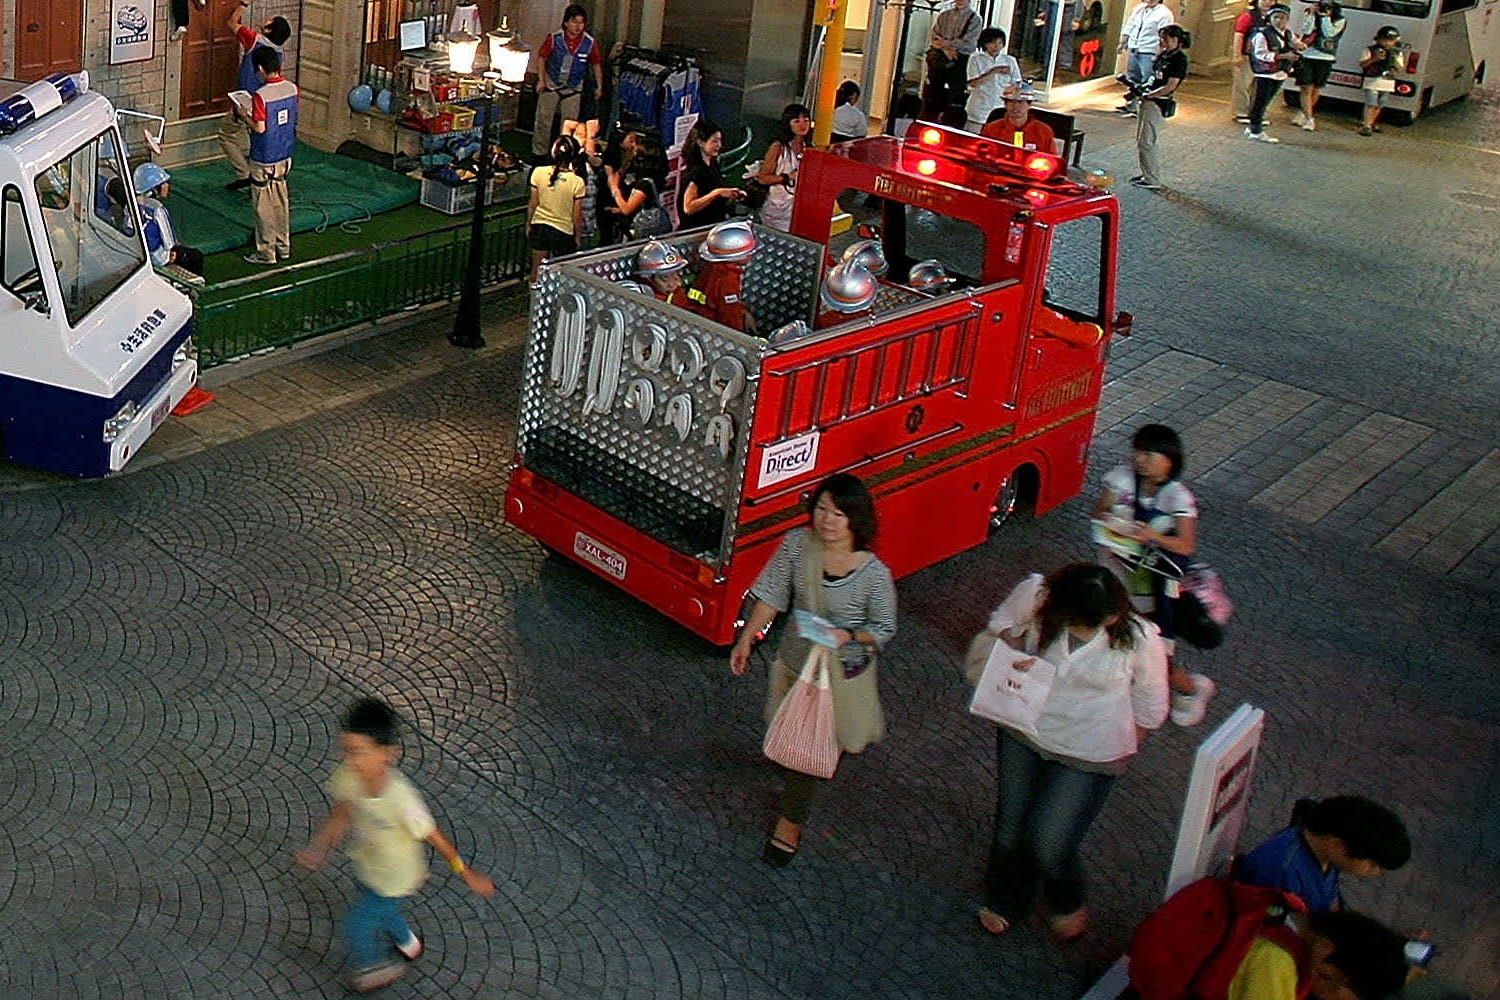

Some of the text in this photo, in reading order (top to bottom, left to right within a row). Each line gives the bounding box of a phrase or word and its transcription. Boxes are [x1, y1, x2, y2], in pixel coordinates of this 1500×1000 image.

[127, 308, 167, 348] 生活救急車
[766, 447, 808, 474] Direct
